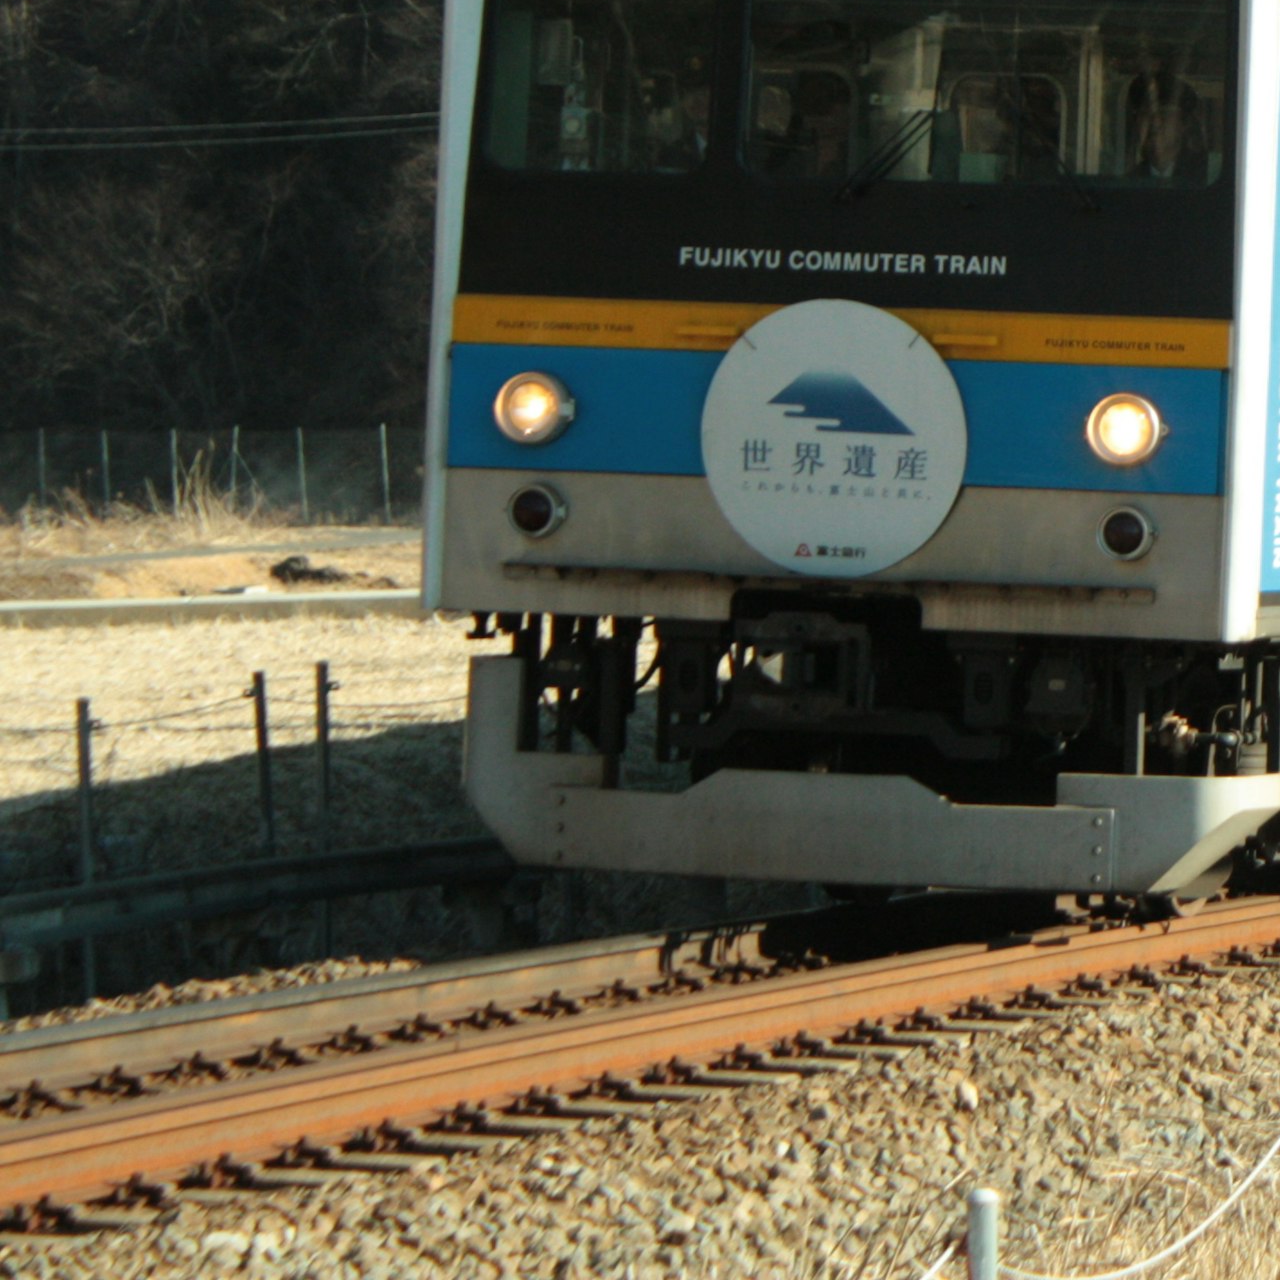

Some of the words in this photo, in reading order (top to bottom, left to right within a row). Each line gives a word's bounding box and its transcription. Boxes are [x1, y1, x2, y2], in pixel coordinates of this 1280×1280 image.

[679, 246, 781, 269] FUJIKYU
[788, 250, 926, 274] COMMUTER
[934, 254, 1007, 276] TRAIN
[1045, 338, 1089, 349] FUJIKYU
[1091, 340, 1151, 351] COMMUTER
[1155, 341, 1185, 352] TRAIN
[740, 439, 928, 481] 世界遺産
